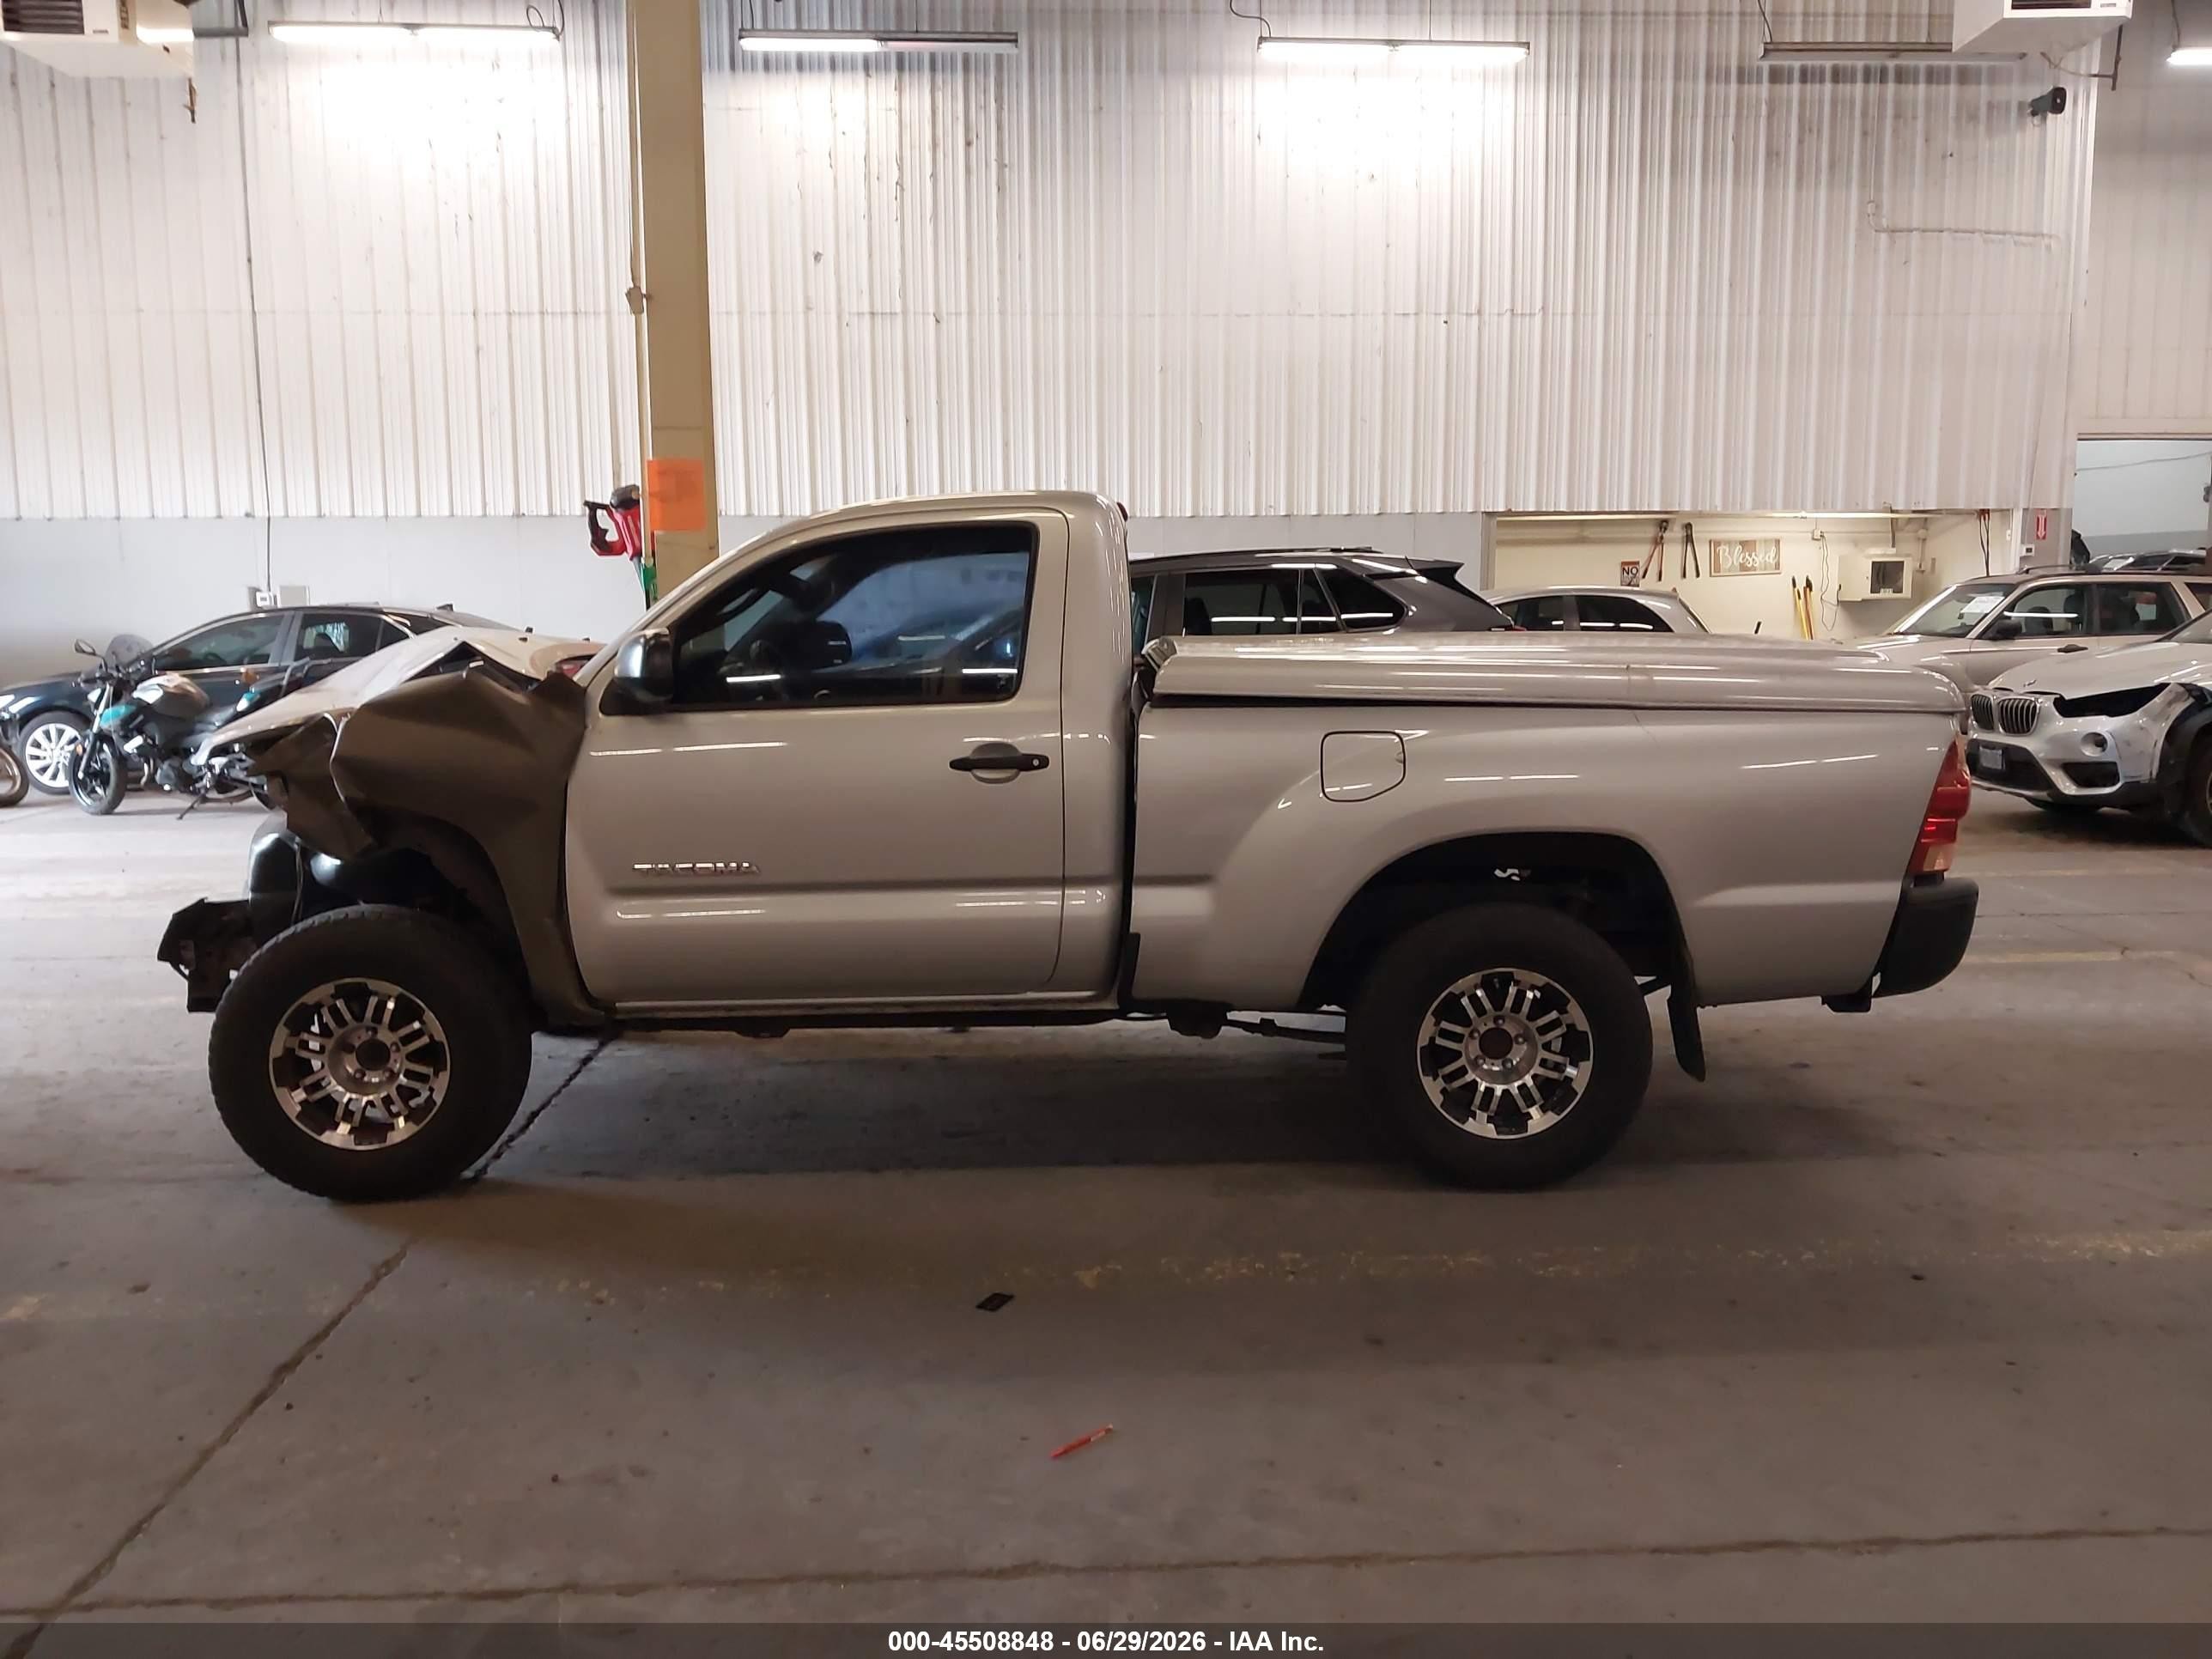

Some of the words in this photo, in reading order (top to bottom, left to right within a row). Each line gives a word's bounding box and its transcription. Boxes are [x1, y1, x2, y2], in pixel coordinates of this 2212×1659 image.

[1717, 544, 1778, 568] Blessed
[1622, 567, 1638, 576] NO
[633, 862, 760, 875] TACOMA
